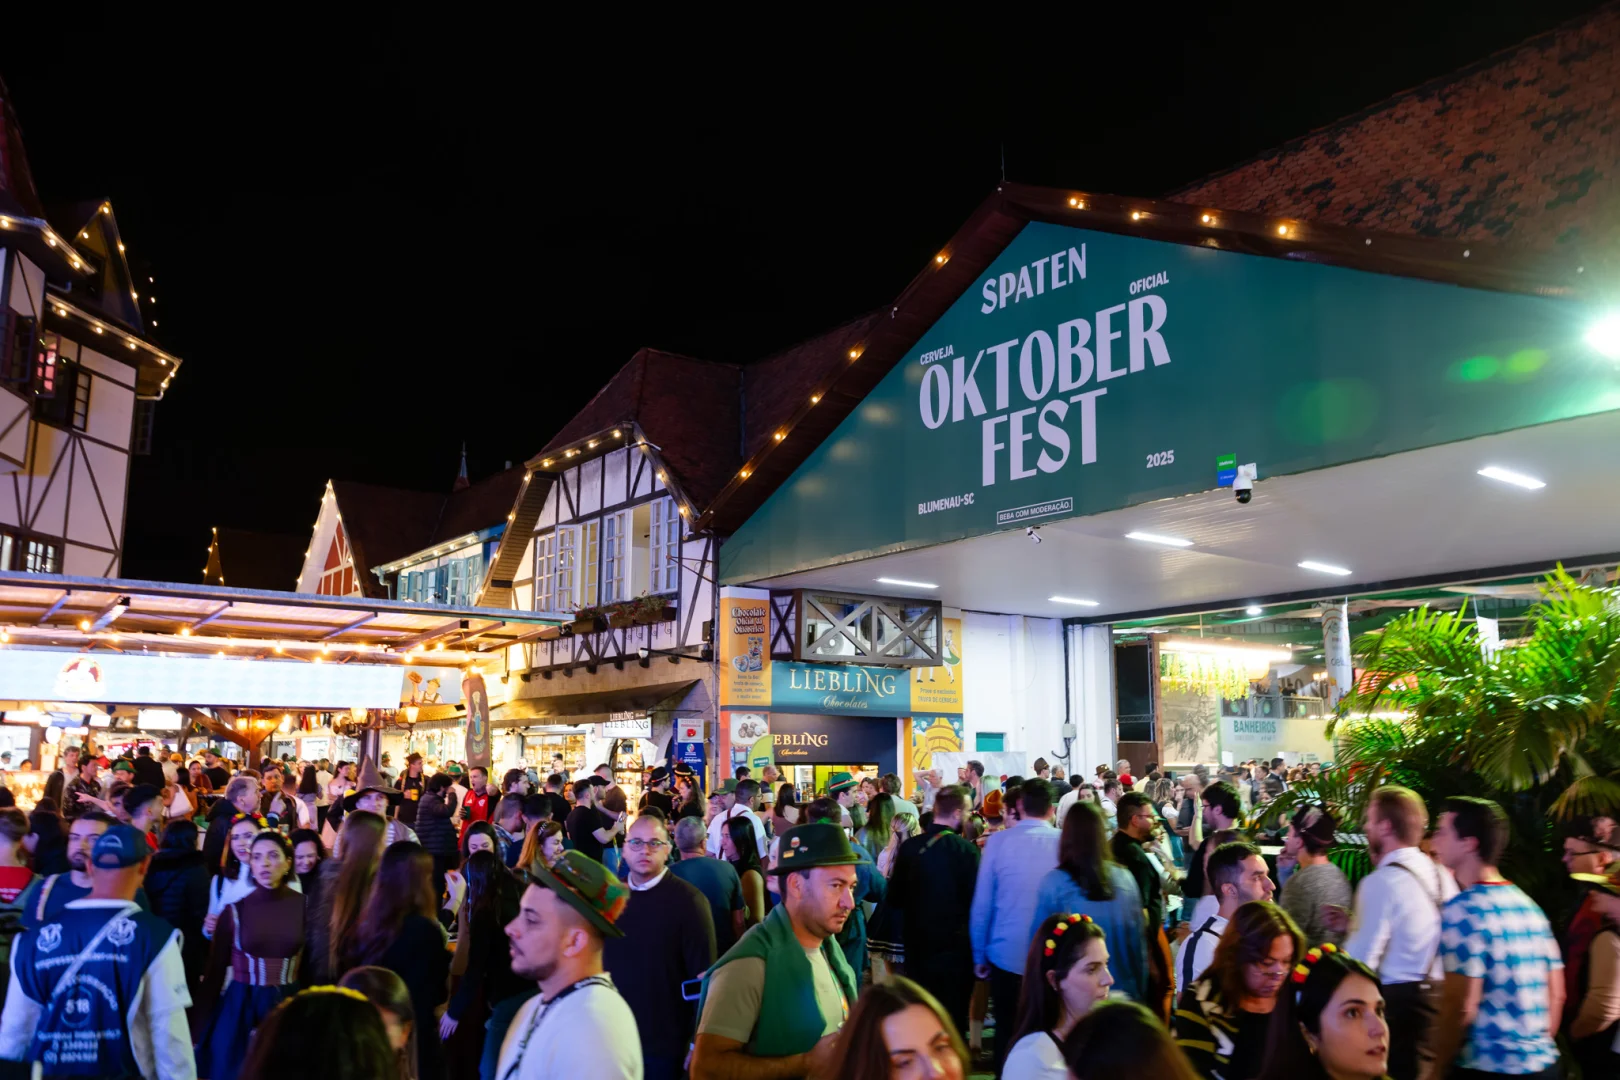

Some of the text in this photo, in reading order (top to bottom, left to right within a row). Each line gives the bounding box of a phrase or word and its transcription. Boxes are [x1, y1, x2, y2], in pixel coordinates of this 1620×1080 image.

[981, 243, 1087, 314] SPATEN
[1129, 271, 1169, 295] OFICIAL
[919, 344, 954, 365] CERVEJA
[919, 294, 1171, 430] OKTOBER
[982, 387, 1108, 487] FEST
[1146, 450, 1175, 469] 2025
[918, 492, 975, 515] BLUMENAU-SC
[999, 512, 1015, 521] BEBA
[1015, 510, 1030, 518] COM
[731, 607, 766, 618] Chocolate
[789, 668, 896, 698] LIEBLING
[818, 695, 868, 711] Chocolates
[609, 711, 634, 721] LIEBLING
[1233, 720, 1277, 733] BANHEIROS
[774, 732, 828, 747] EBLING
